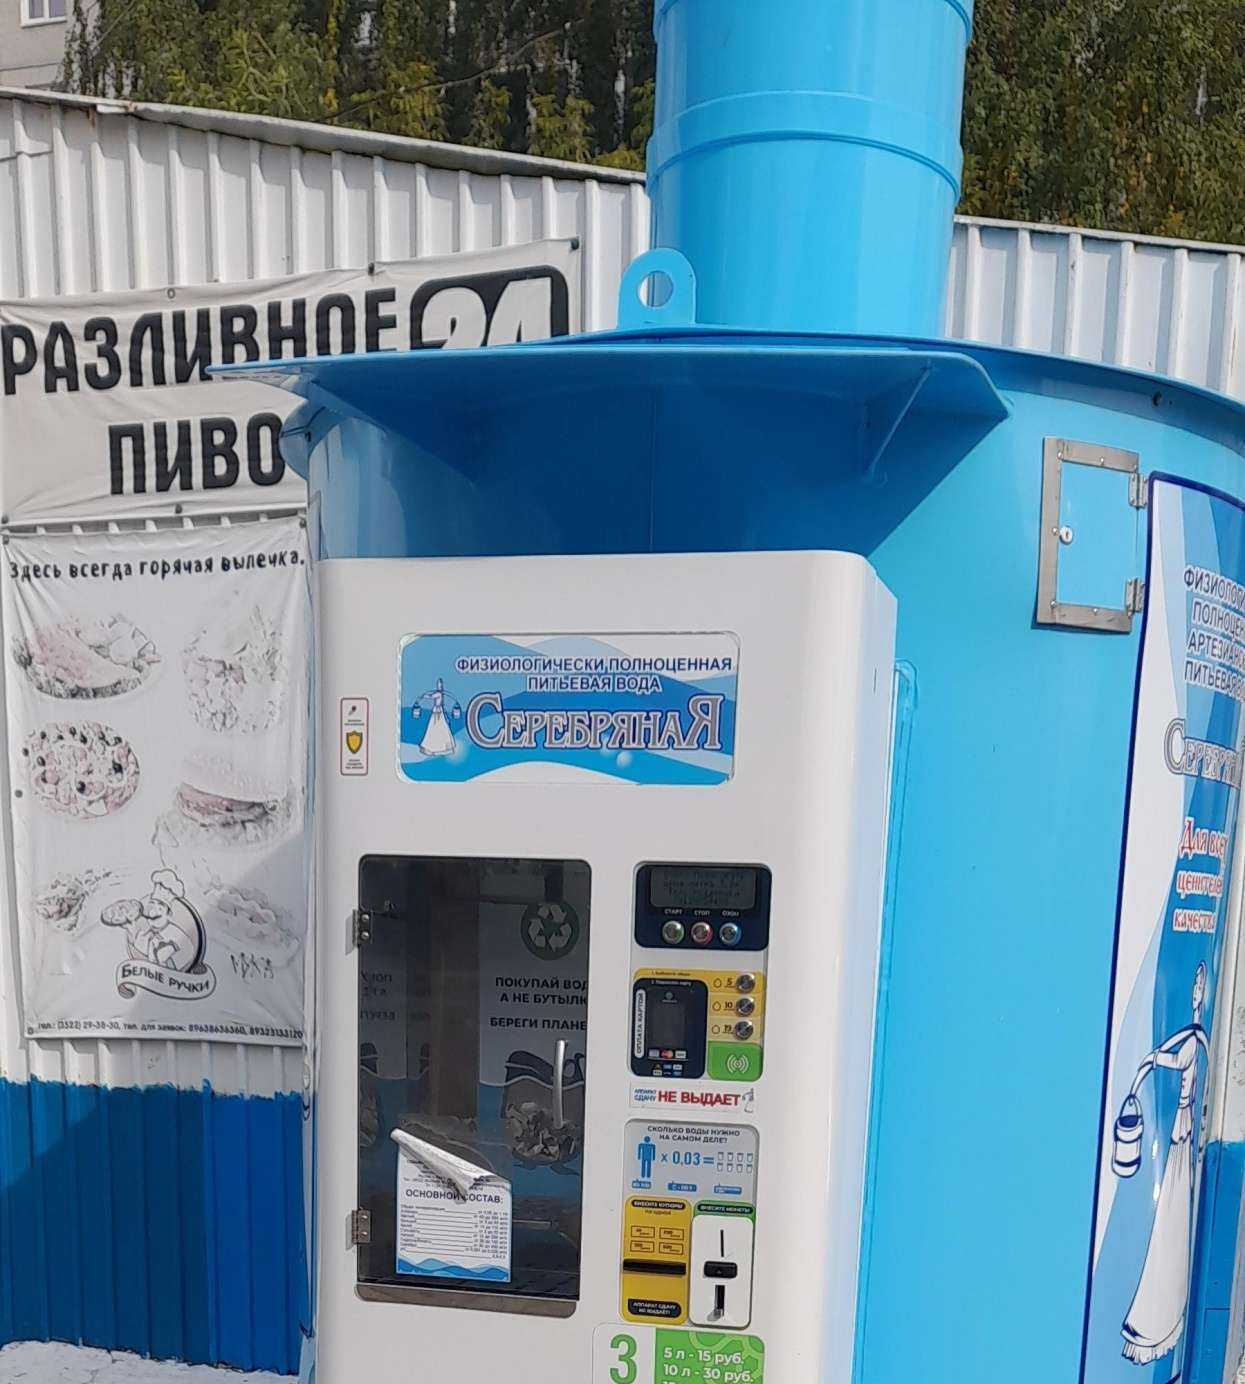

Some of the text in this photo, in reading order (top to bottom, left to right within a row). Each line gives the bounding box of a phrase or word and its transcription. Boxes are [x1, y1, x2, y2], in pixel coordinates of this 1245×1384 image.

[1, 287, 397, 395] РАЗЛИВНОЕ
[108, 412, 287, 495] ПИВО
[9, 562, 62, 583] Здесь
[69, 561, 133, 581] всегда
[140, 556, 214, 581] горячая
[457, 657, 732, 674] ФИЗИОЛОГИЧЕСКИ ПОЛНОЦЕННАЯ
[528, 676, 662, 694] ПИТЬЕВАЯ ВОДА
[169, 977, 210, 993] РУЧКИ
[495, 976, 560, 990] ПОКУПАЙ
[499, 993, 509, 1002] А
[513, 993, 529, 1003] НЕ
[490, 1016, 538, 1029] БЕРЕГИ
[658, 1090, 741, 1107] НЕ ВЫДАЕТ
[647, 1125, 684, 1134] СКОЛЬКО
[685, 1127, 709, 1135] ВОДЫ
[672, 1134, 701, 1142] САМОМ
[702, 1136, 728, 1144] ДЕЛЕ?
[610, 1334, 637, 1384] 3
[663, 1347, 672, 1358] 5
[676, 1350, 685, 1359] л
[698, 1350, 711, 1361] 15
[714, 1352, 744, 1365] руб.
[664, 1364, 678, 1375] 10
[682, 1367, 691, 1377] л
[703, 1367, 720, 1379] 30
[724, 1369, 753, 1383] руб.
